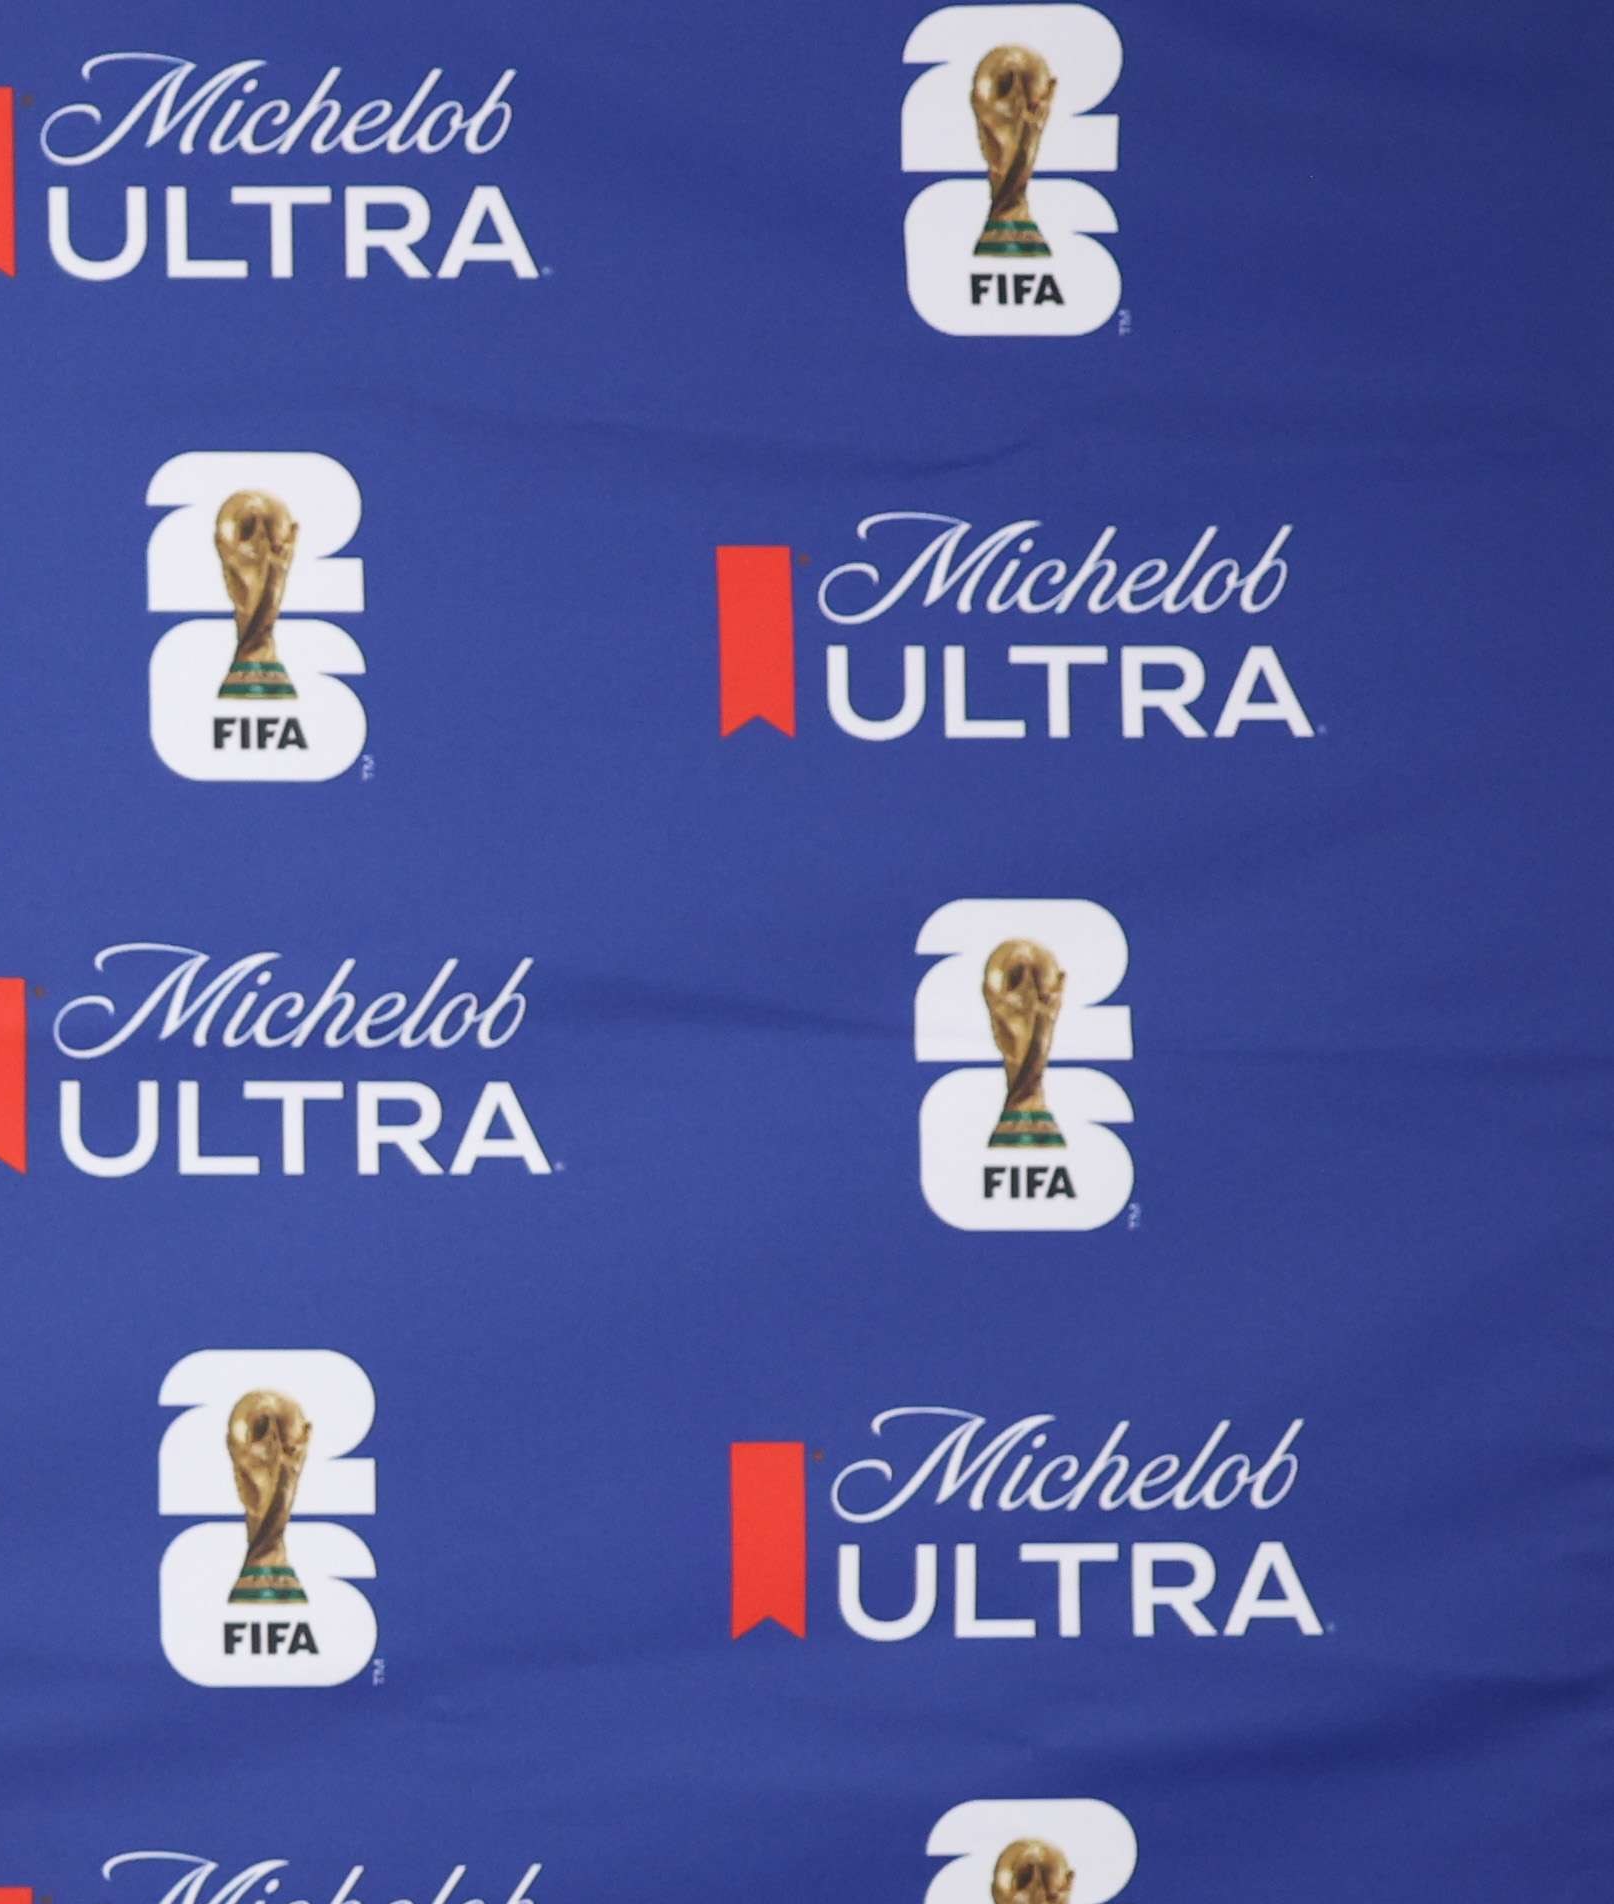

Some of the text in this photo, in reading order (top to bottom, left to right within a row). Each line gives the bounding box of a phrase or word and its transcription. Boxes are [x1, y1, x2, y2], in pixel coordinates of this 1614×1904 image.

[40, 53, 516, 166] Michelob
[47, 186, 539, 282] ULTRA
[970, 273, 1064, 305] FIFA
[818, 512, 1292, 624] Michelob
[213, 717, 307, 750] FIFA
[826, 645, 1314, 741] ULTRA
[53, 943, 533, 1059] Michelob
[60, 1080, 552, 1178] ULTRA
[983, 1166, 1076, 1199] FIFA
[831, 1407, 1303, 1523] Michelob
[224, 1622, 319, 1655] FIFA
[838, 1542, 1323, 1642] ULTRA
